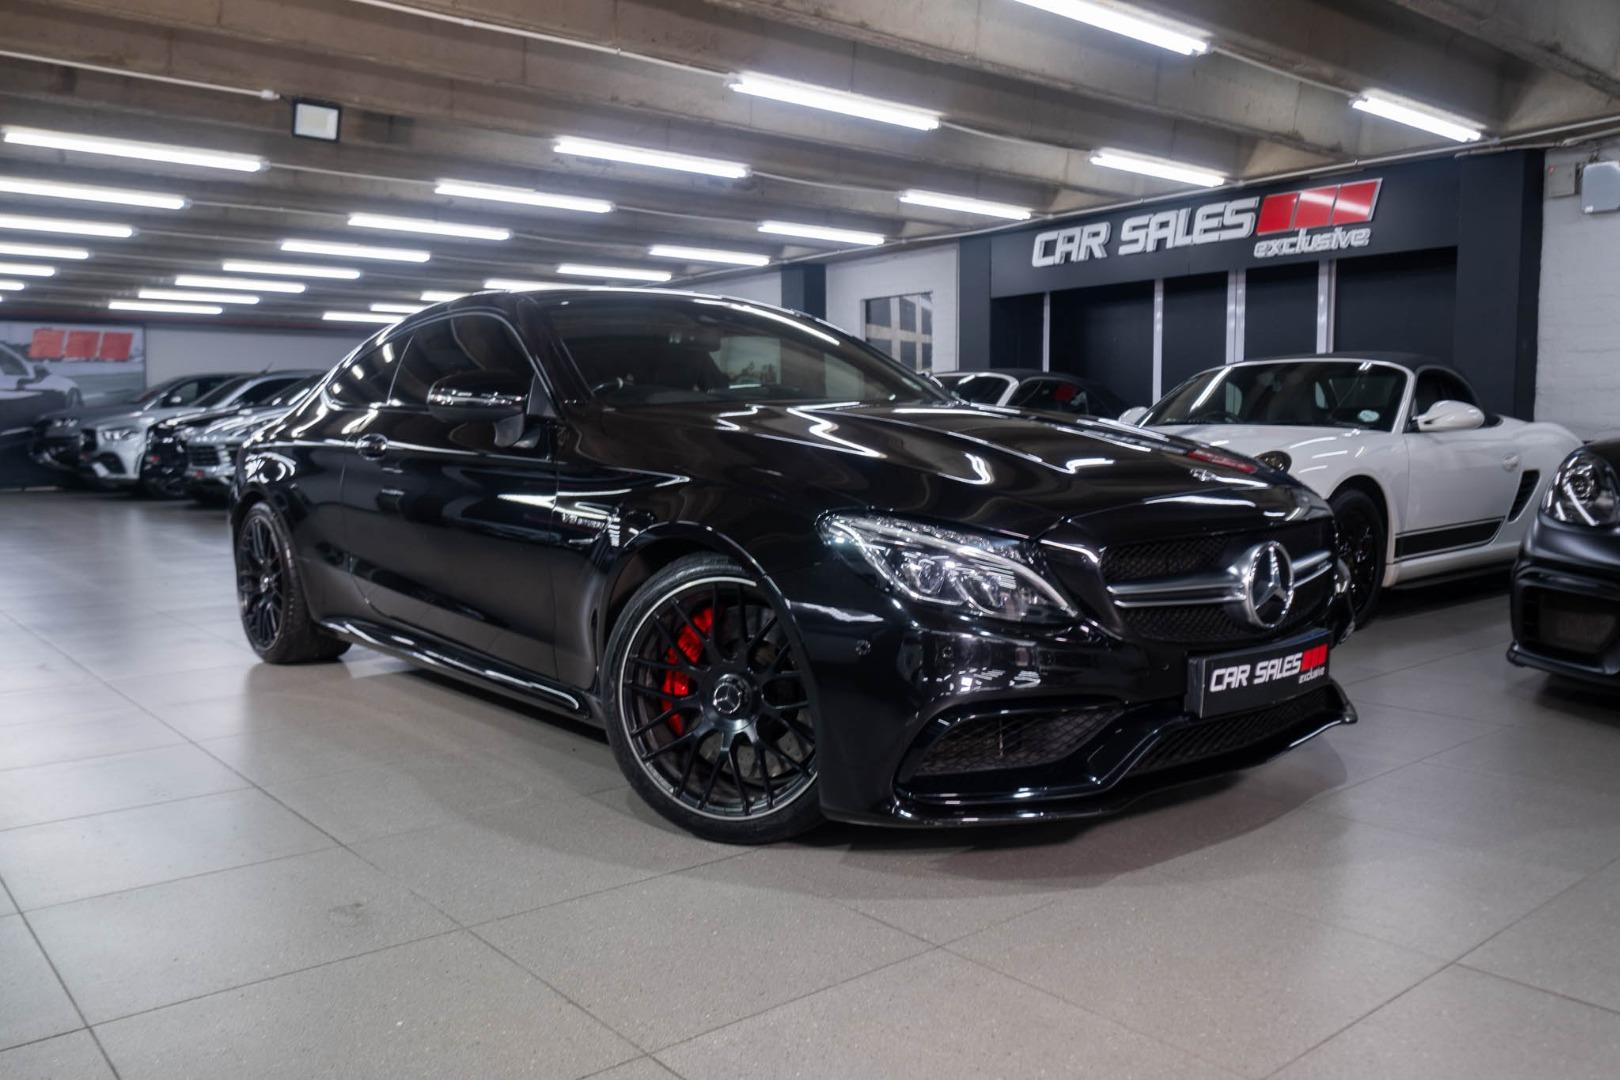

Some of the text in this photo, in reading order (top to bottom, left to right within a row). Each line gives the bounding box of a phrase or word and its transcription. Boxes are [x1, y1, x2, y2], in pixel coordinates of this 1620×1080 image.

[1032, 196, 1260, 267] CAR SALES
[1253, 227, 1371, 258] exclusive
[1210, 653, 1303, 692] CAR SALES
